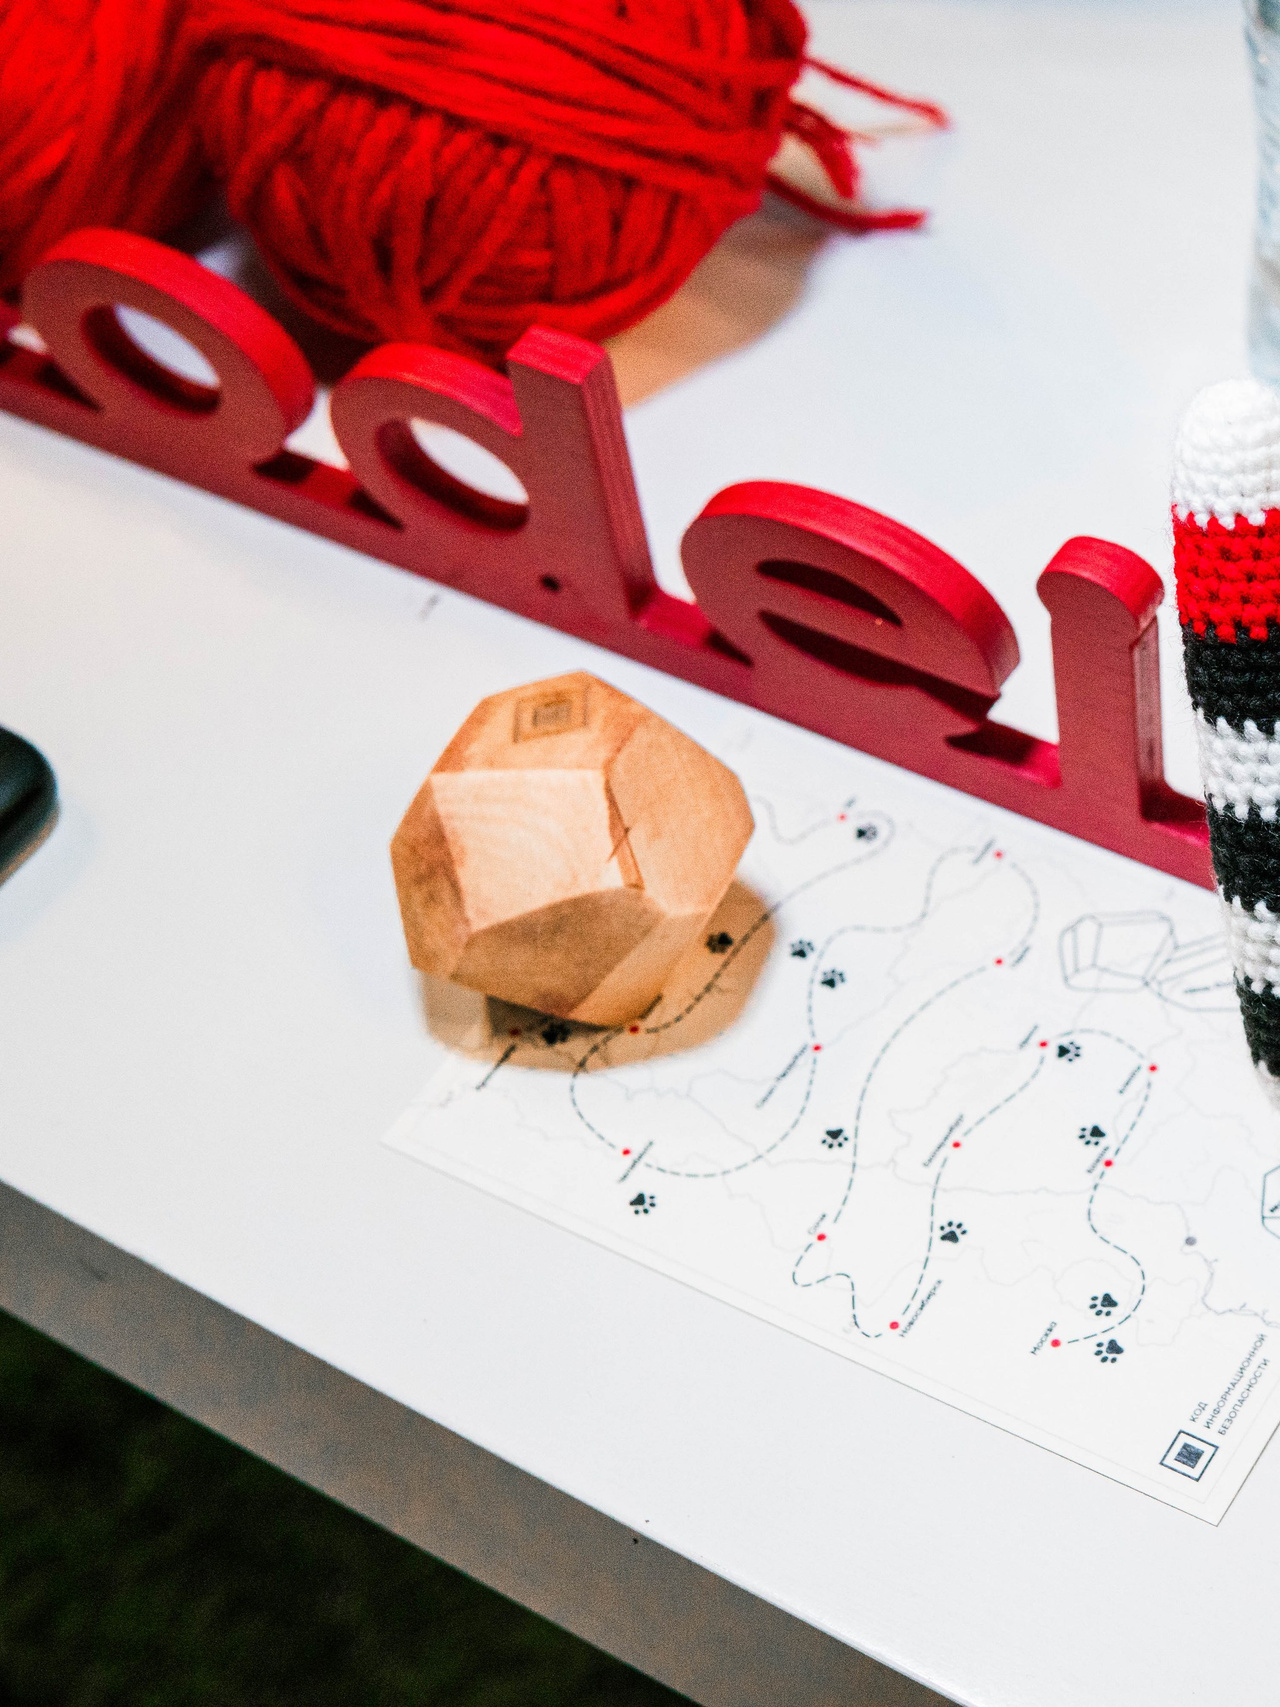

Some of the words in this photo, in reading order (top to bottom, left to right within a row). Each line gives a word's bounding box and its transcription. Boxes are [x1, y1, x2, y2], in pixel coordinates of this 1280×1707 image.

[1031, 1321, 1057, 1355] Москва
[1203, 1333, 1268, 1430] ИНФОРМАЦИОННОЙ
[1217, 1358, 1270, 1435] БЕЗОПАСНОСТИ
[1188, 1401, 1208, 1422] КОД
